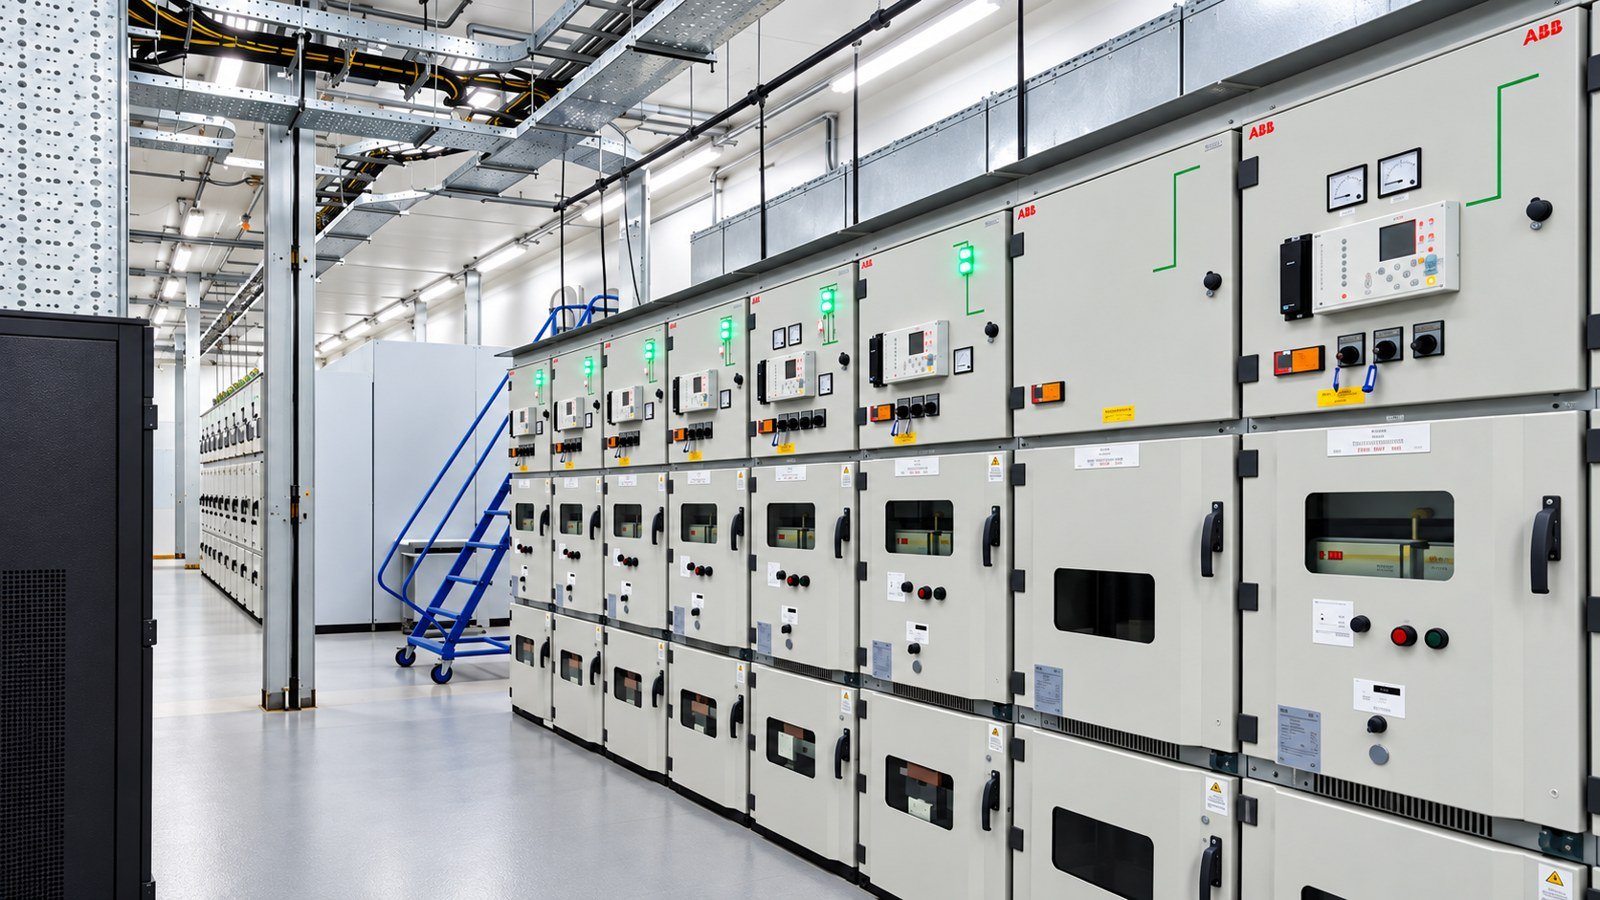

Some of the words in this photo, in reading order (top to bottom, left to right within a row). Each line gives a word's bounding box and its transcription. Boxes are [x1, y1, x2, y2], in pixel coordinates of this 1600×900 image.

[1523, 19, 1563, 46] ABB
[1248, 121, 1275, 140] ABB
[1017, 205, 1036, 220] ABB
